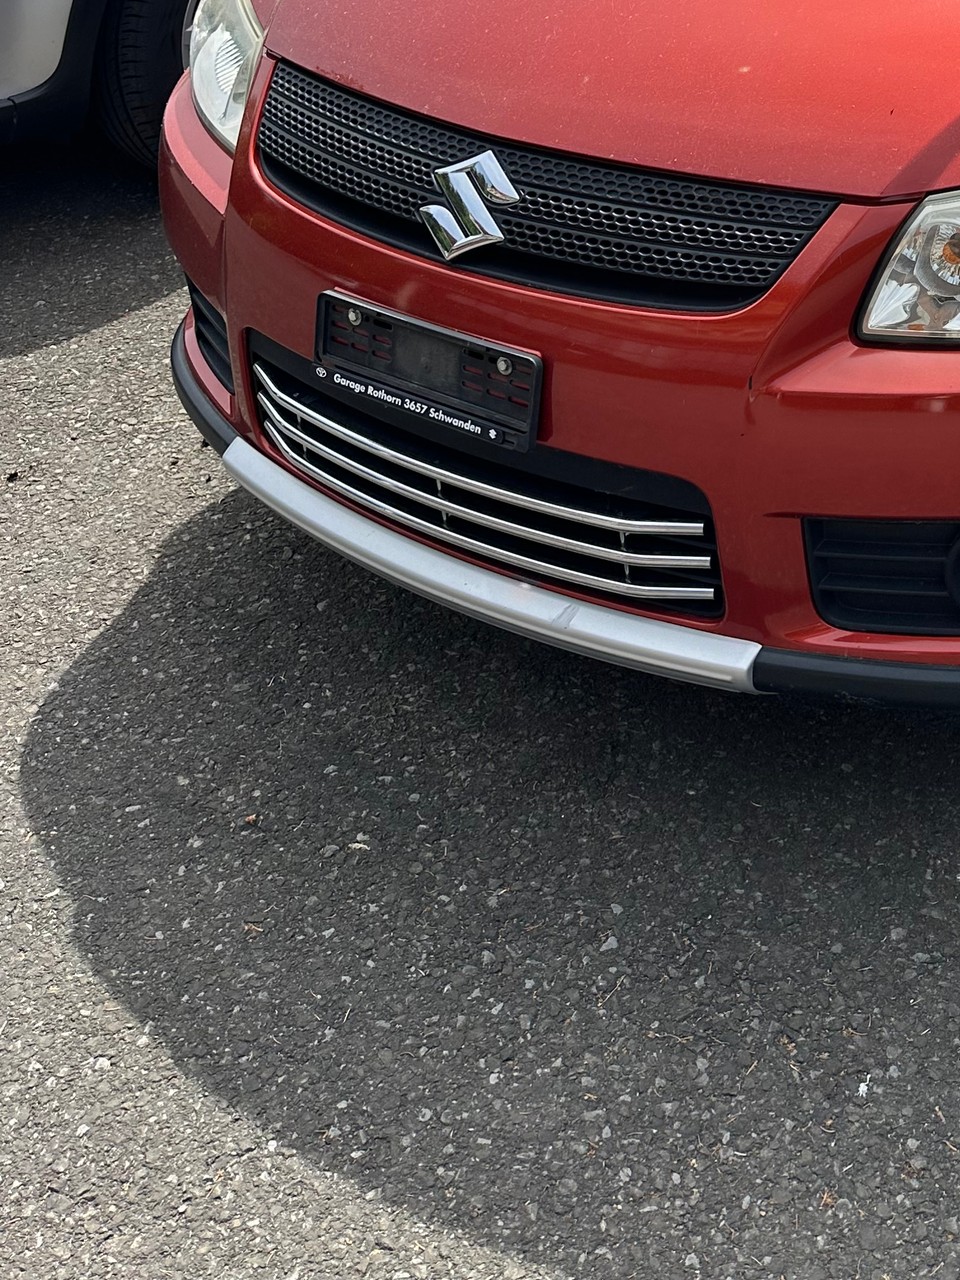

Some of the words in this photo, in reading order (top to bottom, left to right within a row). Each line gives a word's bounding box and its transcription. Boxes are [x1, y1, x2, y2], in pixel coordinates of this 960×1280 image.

[333, 373, 366, 393] Garage
[367, 385, 402, 406] Rothorn
[403, 398, 428, 414] 3657
[428, 407, 482, 435] Schwanden
